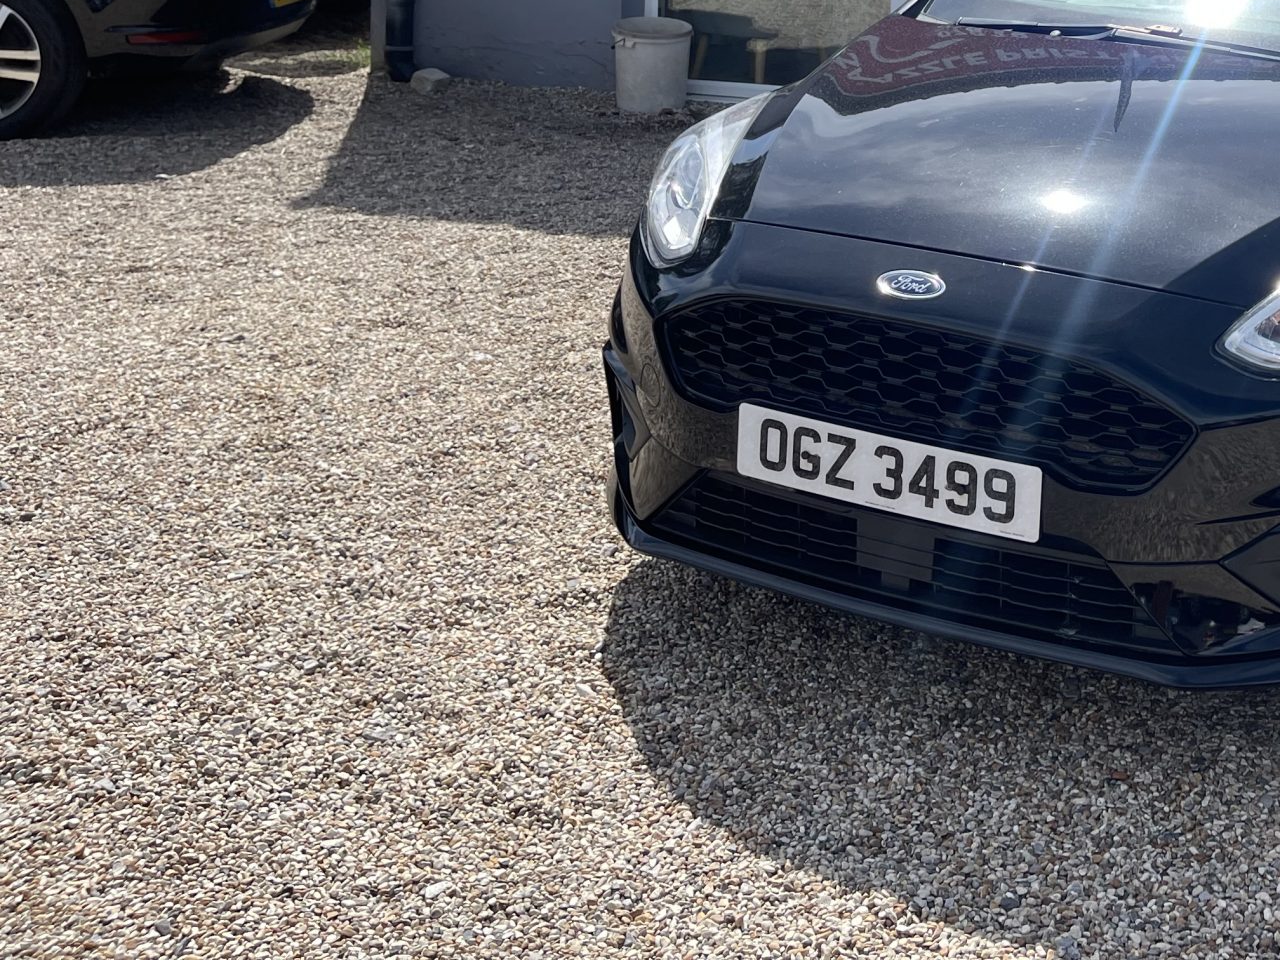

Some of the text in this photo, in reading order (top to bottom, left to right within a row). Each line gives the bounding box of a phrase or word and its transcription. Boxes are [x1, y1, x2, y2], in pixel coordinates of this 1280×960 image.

[891, 274, 932, 294] Ford
[758, 417, 1017, 525] OGZ 3499
